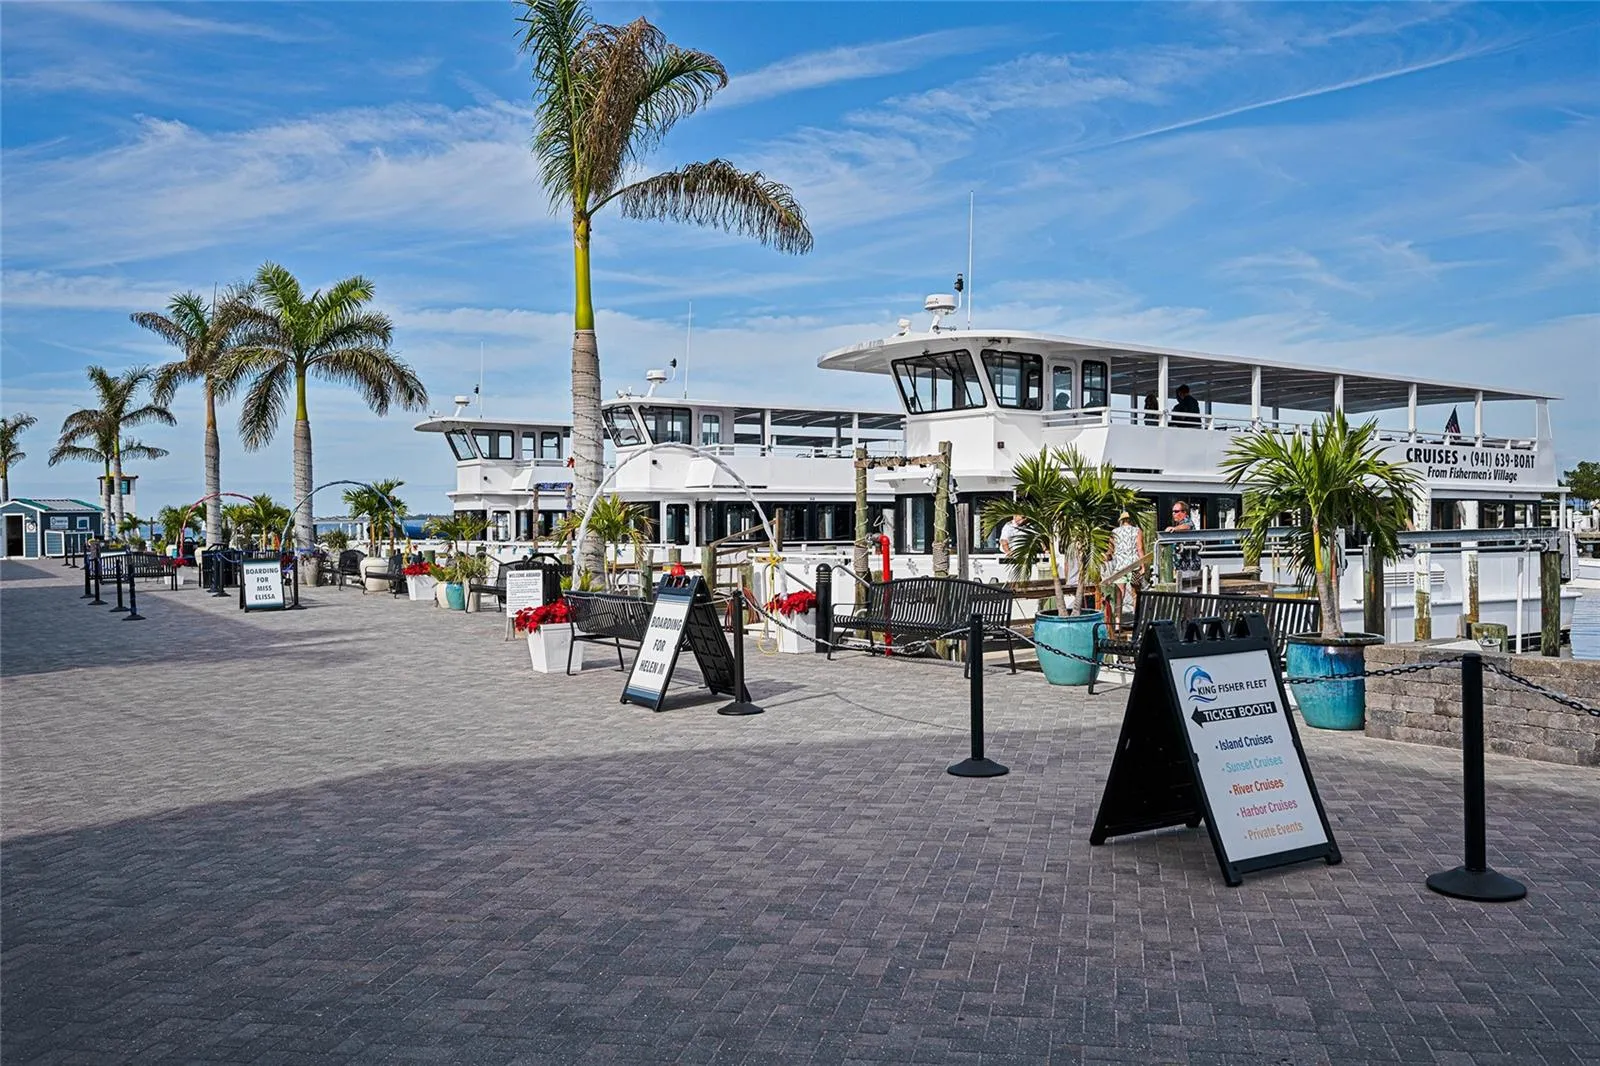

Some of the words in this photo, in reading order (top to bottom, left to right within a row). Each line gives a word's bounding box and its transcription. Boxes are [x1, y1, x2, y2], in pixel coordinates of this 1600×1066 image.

[1406, 447, 1459, 465] CRUISES
[1470, 451, 1492, 468] (941)
[1495, 453, 1535, 469] 639-BOAT
[1427, 466, 1447, 479] From
[1449, 467, 1492, 480] Fishermen's
[1493, 469, 1517, 483] Village
[245, 567, 279, 575] BOARDING
[651, 616, 682, 631] BOARDING
[652, 639, 666, 652] FOR
[639, 659, 659, 673] HELEN
[1197, 685, 1217, 695] KING
[1218, 682, 1245, 693] FISHER
[1245, 679, 1267, 690] FLEET
[1203, 707, 1237, 721] TICKET
[1238, 703, 1273, 717] BOOTH
[1218, 737, 1244, 751] Island
[1244, 734, 1274, 747] Cruises
[1225, 759, 1254, 773] Sunset
[1254, 756, 1284, 769] Cruises
[1232, 782, 1254, 795] River
[1254, 778, 1284, 791] Cruises
[1240, 804, 1267, 818] Harbor
[1268, 800, 1298, 813] Cruises
[1247, 827, 1277, 840] Private
[1276, 821, 1304, 835] Events
